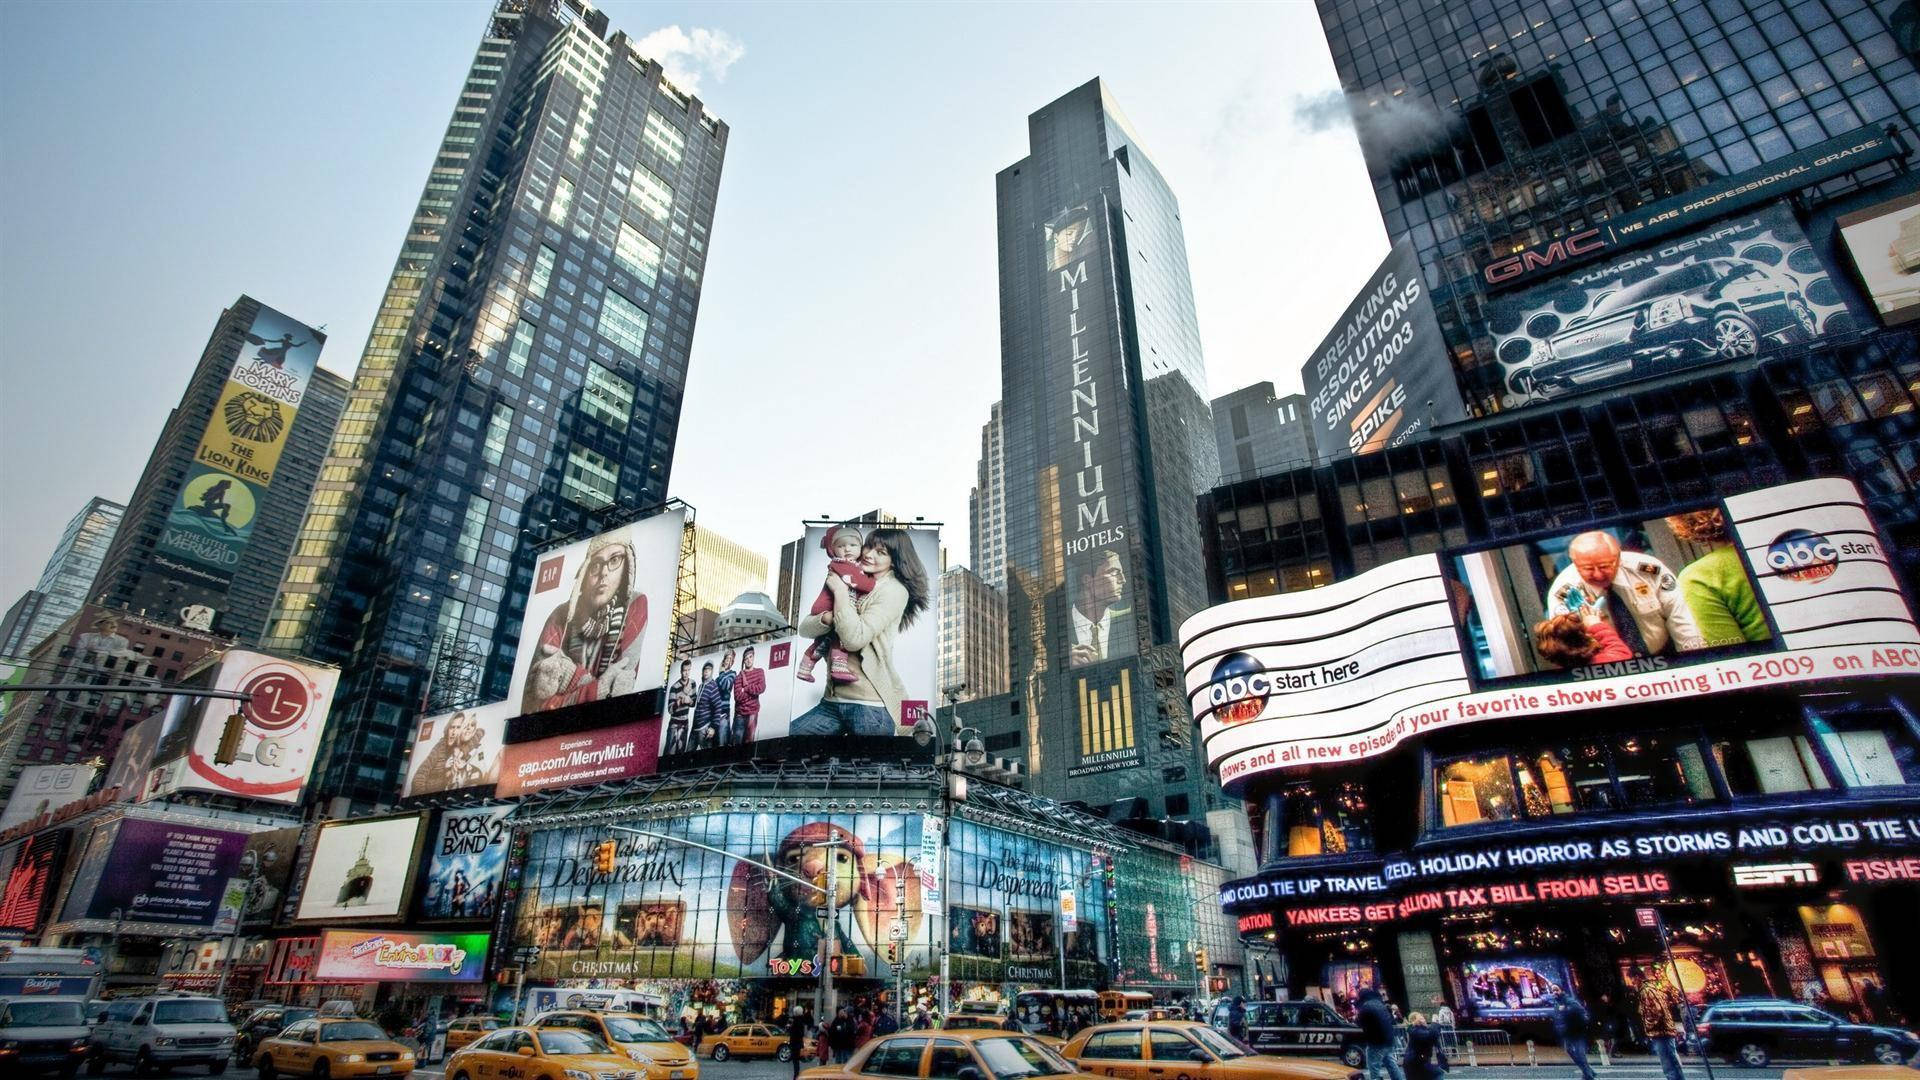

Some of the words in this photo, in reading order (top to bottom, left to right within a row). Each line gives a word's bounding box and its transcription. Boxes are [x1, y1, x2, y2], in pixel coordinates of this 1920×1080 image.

[1619, 220, 1644, 236] WE
[1648, 208, 1680, 226] ARE
[1682, 164, 1810, 215] PROFESSIONAL
[1484, 228, 1606, 286] GMC
[1572, 253, 1654, 287] YUKON
[1659, 218, 1761, 260] DENALI
[1317, 272, 1398, 381] BREAKING
[1310, 278, 1421, 420] RESOLUTIONS
[234, 366, 301, 403] POPPINS
[249, 361, 298, 388] MARY
[1326, 367, 1373, 431] SINCE
[1373, 321, 1414, 378] 2003
[1060, 260, 1110, 532] MILLENNIUM
[1349, 383, 1407, 454] SPIKE
[1391, 418, 1421, 449] ACTION
[199, 445, 234, 468] LION
[235, 459, 270, 481] KING
[231, 442, 254, 459] THE
[161, 530, 239, 565] MERMAID
[183, 530, 201, 542] THE
[202, 536, 229, 550] LITTLE
[1066, 525, 1124, 555] HOTELS
[1767, 538, 1838, 566] abc
[1841, 541, 1878, 555] start
[542, 567, 557, 584] GAP
[774, 651, 787, 662] GAP
[1571, 655, 1669, 682] SIEMENS
[1209, 670, 1271, 707] abc
[1275, 672, 1317, 690] start
[1322, 660, 1360, 686] here
[1220, 758, 1247, 781] shows
[1250, 750, 1276, 768] and
[1281, 746, 1301, 761] all
[1307, 745, 1342, 758] new
[1395, 716, 1406, 734] of
[1410, 708, 1449, 733] your
[1458, 693, 1540, 719] favorite
[1548, 684, 1616, 708] shows
[1624, 674, 1711, 700] coming
[1717, 667, 1742, 687] in
[1747, 655, 1815, 682] 2009
[1832, 652, 1864, 671] on
[560, 739, 592, 751] Experience
[1082, 748, 1137, 765] MILLENNIUM
[518, 742, 635, 777] gap.com/MerryMixIt
[1069, 766, 1103, 776] BROADWAY
[1106, 762, 1121, 770] NEW
[1122, 759, 1139, 768] YORK
[521, 780, 526, 788] A
[527, 777, 549, 788] surprise
[550, 775, 562, 783] cast
[563, 773, 570, 781] of
[570, 770, 595, 780] carolers
[595, 767, 608, 776] and
[446, 815, 489, 840] ROCK
[489, 820, 504, 845] 2
[163, 848, 184, 856] PLANET
[184, 850, 216, 860] HOLLYWOOD
[441, 834, 489, 856] BAND
[614, 836, 644, 858] Tale
[647, 839, 664, 863] of
[1421, 851, 1500, 876] HOLIDAY
[1508, 843, 1593, 866] HORROR
[1600, 840, 1629, 857] AS
[1636, 832, 1730, 854] STORMS
[1737, 828, 1787, 848] AND
[1793, 822, 1859, 844] COLD
[1863, 820, 1906, 840] TIE
[162, 864, 178, 872] NEED
[1000, 848, 1020, 870] The
[1022, 853, 1043, 875] Tale
[1045, 858, 1056, 882] of
[1733, 863, 1819, 886] ESPN
[1238, 884, 1268, 900] COLD
[1271, 882, 1296, 895] TIE
[1300, 879, 1320, 893] UP
[1324, 876, 1387, 892] TRAVEL
[1286, 907, 1361, 924] YANKEES
[1365, 904, 1395, 920] GET
[1446, 889, 1486, 907] TAX
[1492, 885, 1535, 903] BILL
[1538, 880, 1598, 899] FROM
[1604, 873, 1670, 895] SELIG
[175, 898, 211, 907] hollywood
[572, 960, 639, 976] CHRISTMAS
[1008, 965, 1053, 979] CHRISTMAS
[25, 978, 62, 990] Budget
[1299, 1033, 1333, 1043] NYPD
